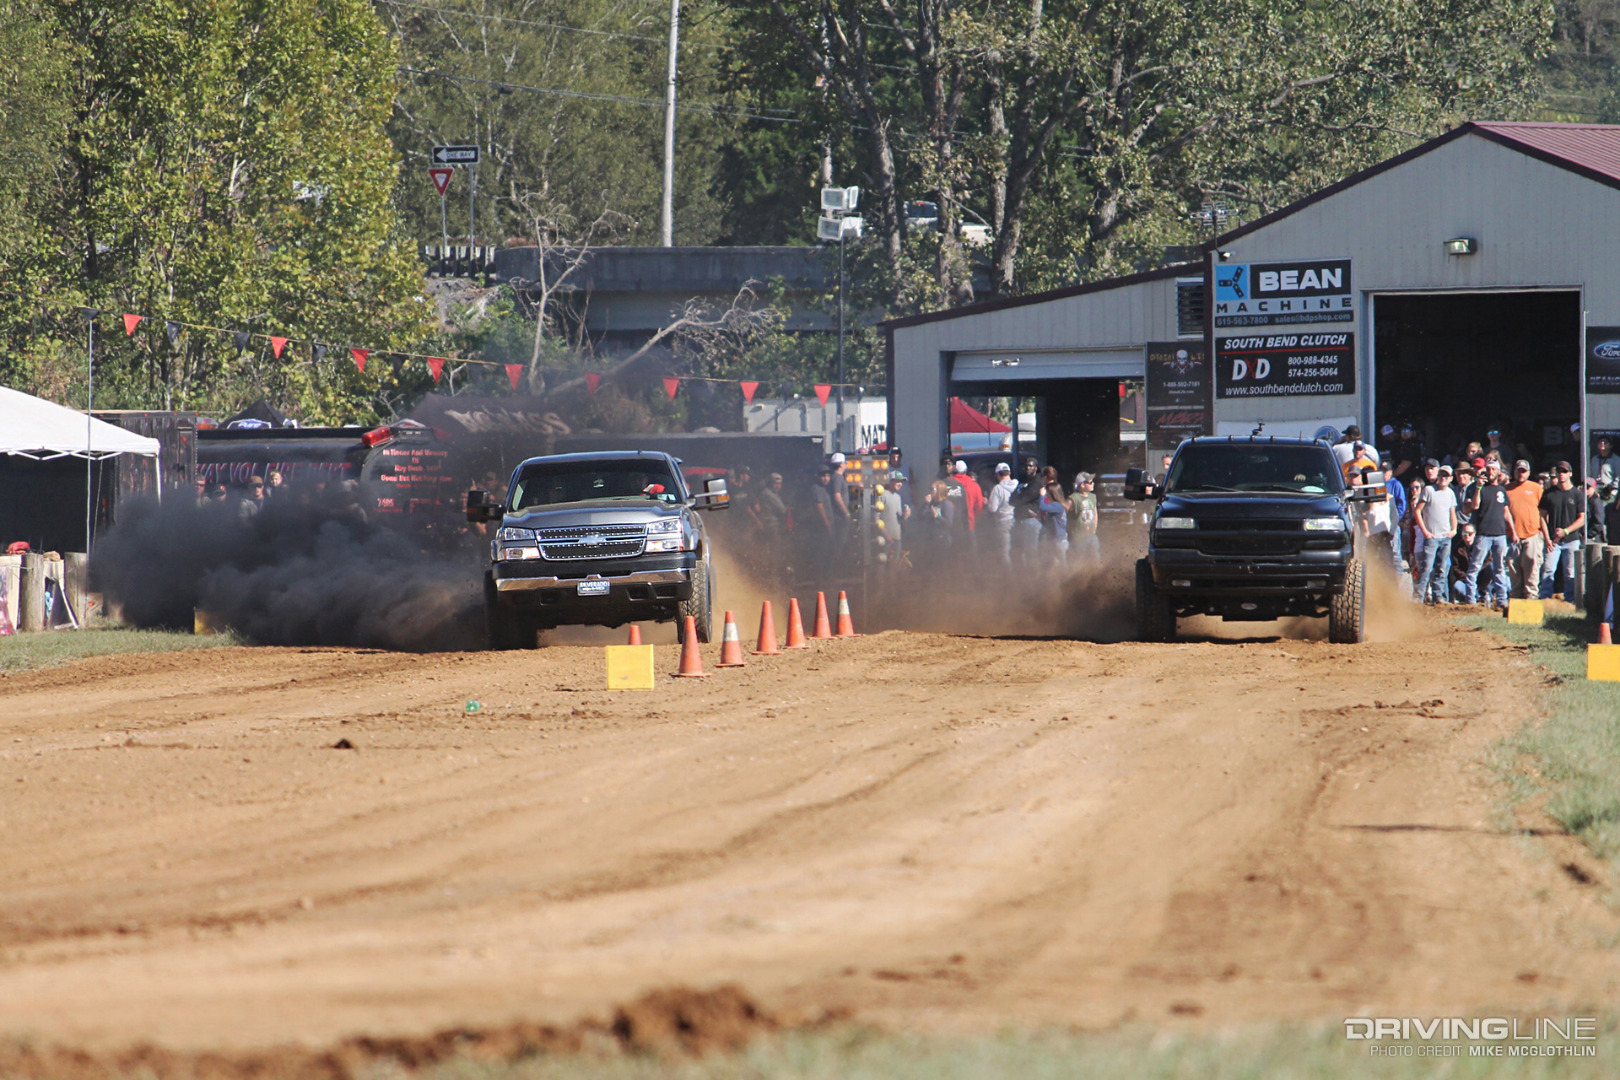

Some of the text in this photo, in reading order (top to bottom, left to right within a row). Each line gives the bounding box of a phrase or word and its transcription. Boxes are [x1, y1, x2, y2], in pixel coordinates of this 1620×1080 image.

[1259, 268, 1342, 292] BEAN
[1216, 297, 1352, 313] MACHINE
[1217, 316, 1269, 326] 615-563-7800
[1224, 334, 1347, 350] SOUTH BEND CLUTCH
[1287, 355, 1338, 366] 800-988-4345
[1287, 367, 1338, 378] 574-256-5064
[1225, 382, 1344, 396] www.southbendclutch.com
